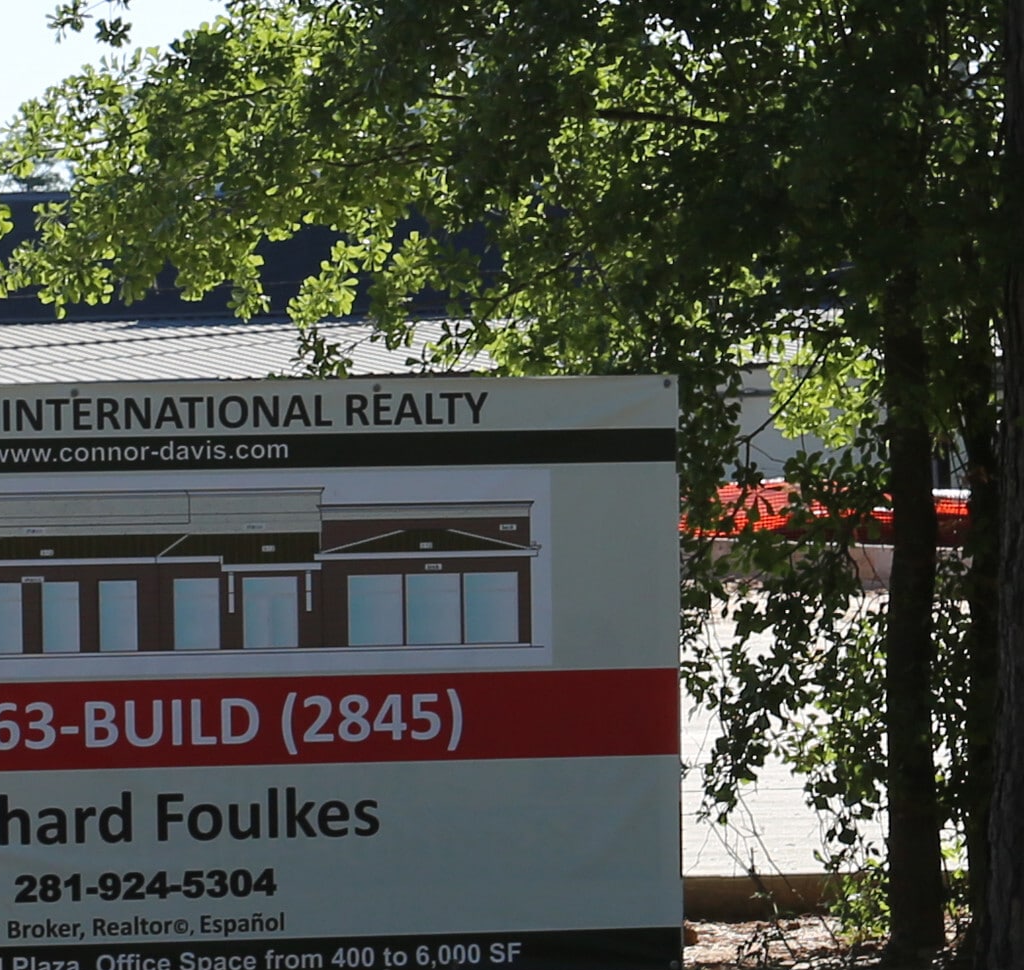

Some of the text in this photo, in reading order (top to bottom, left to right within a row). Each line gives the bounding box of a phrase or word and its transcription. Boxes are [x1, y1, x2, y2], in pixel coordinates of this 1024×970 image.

[2, 394, 333, 432] INTERNATIONAL
[345, 391, 489, 427] REALTY
[281, 688, 463, 755] (2845)
[156, 786, 380, 842] Foulkes
[14, 868, 277, 903] 281-924-5304
[7, 919, 85, 941] Broker,
[200, 912, 285, 937] Español
[331, 946, 375, 968] 400
[383, 947, 408, 967] to
[415, 943, 481, 970] 6,000
[489, 942, 522, 964] SF
